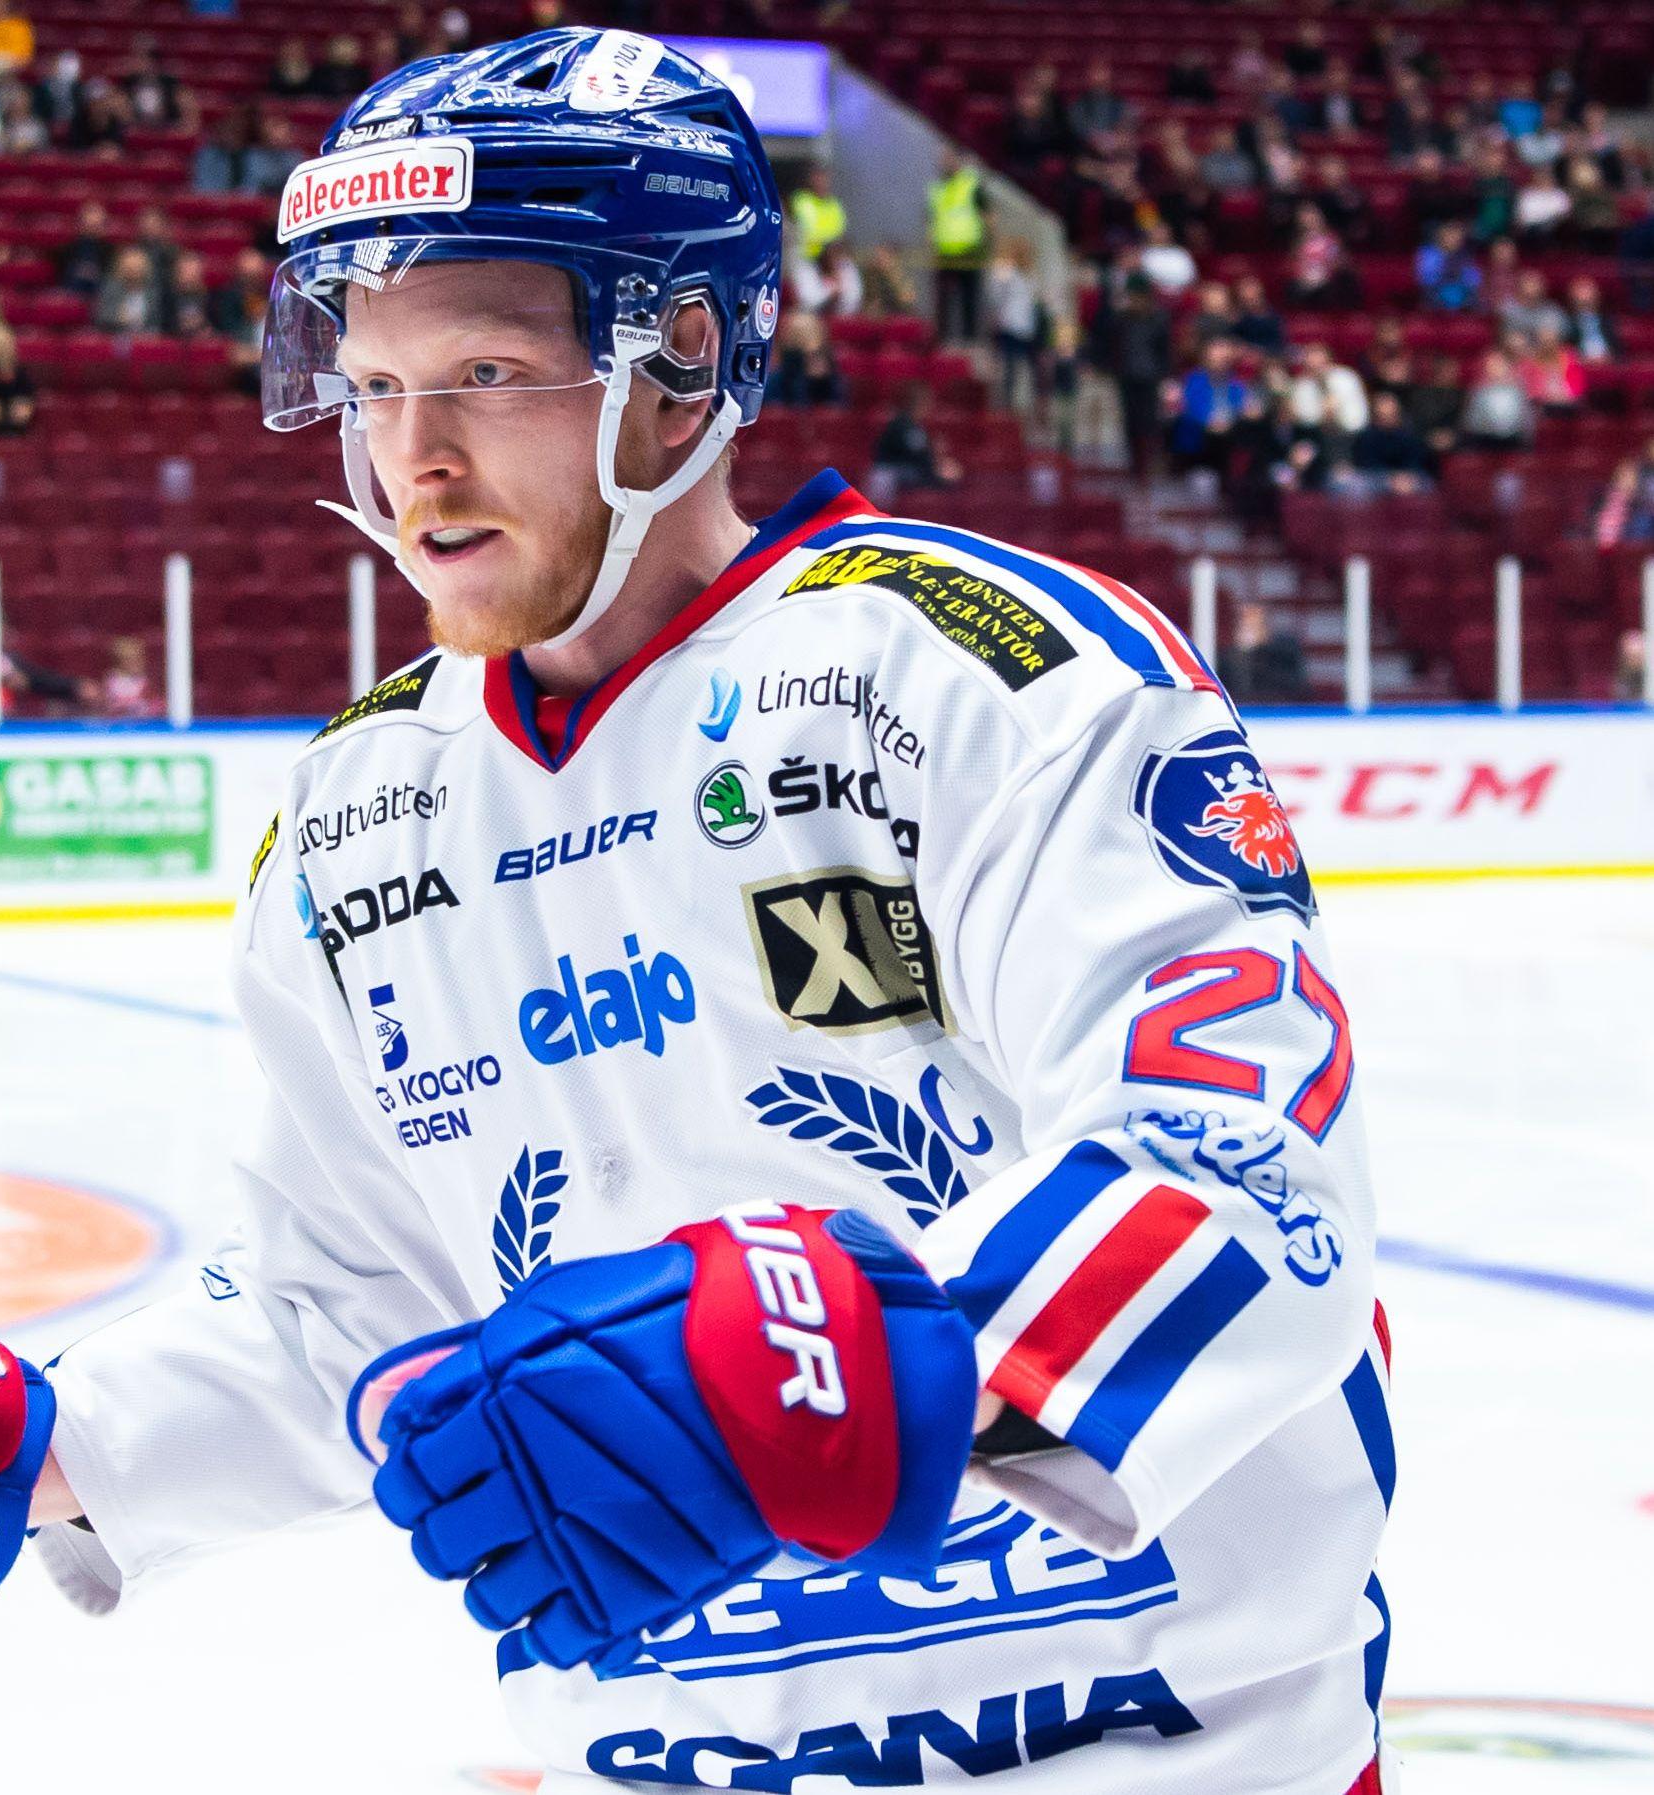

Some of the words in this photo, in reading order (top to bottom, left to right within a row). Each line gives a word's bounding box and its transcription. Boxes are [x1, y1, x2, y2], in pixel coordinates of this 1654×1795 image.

[335, 116, 415, 149] BAUER
[645, 173, 730, 201] BAUER
[616, 328, 660, 344] BAUER
[908, 568, 1045, 673] LEVERANTÖR
[947, 575, 1045, 638] FÖNSTER
[494, 810, 658, 884] BAUER
[519, 933, 696, 1065] elajo
[1122, 940, 1355, 1146] 27
[399, 1055, 501, 1106] KOGYO
[919, 1063, 994, 1156] C
[395, 1107, 472, 1149] EDEN
[586, 1668, 1205, 1795] SCANIA
